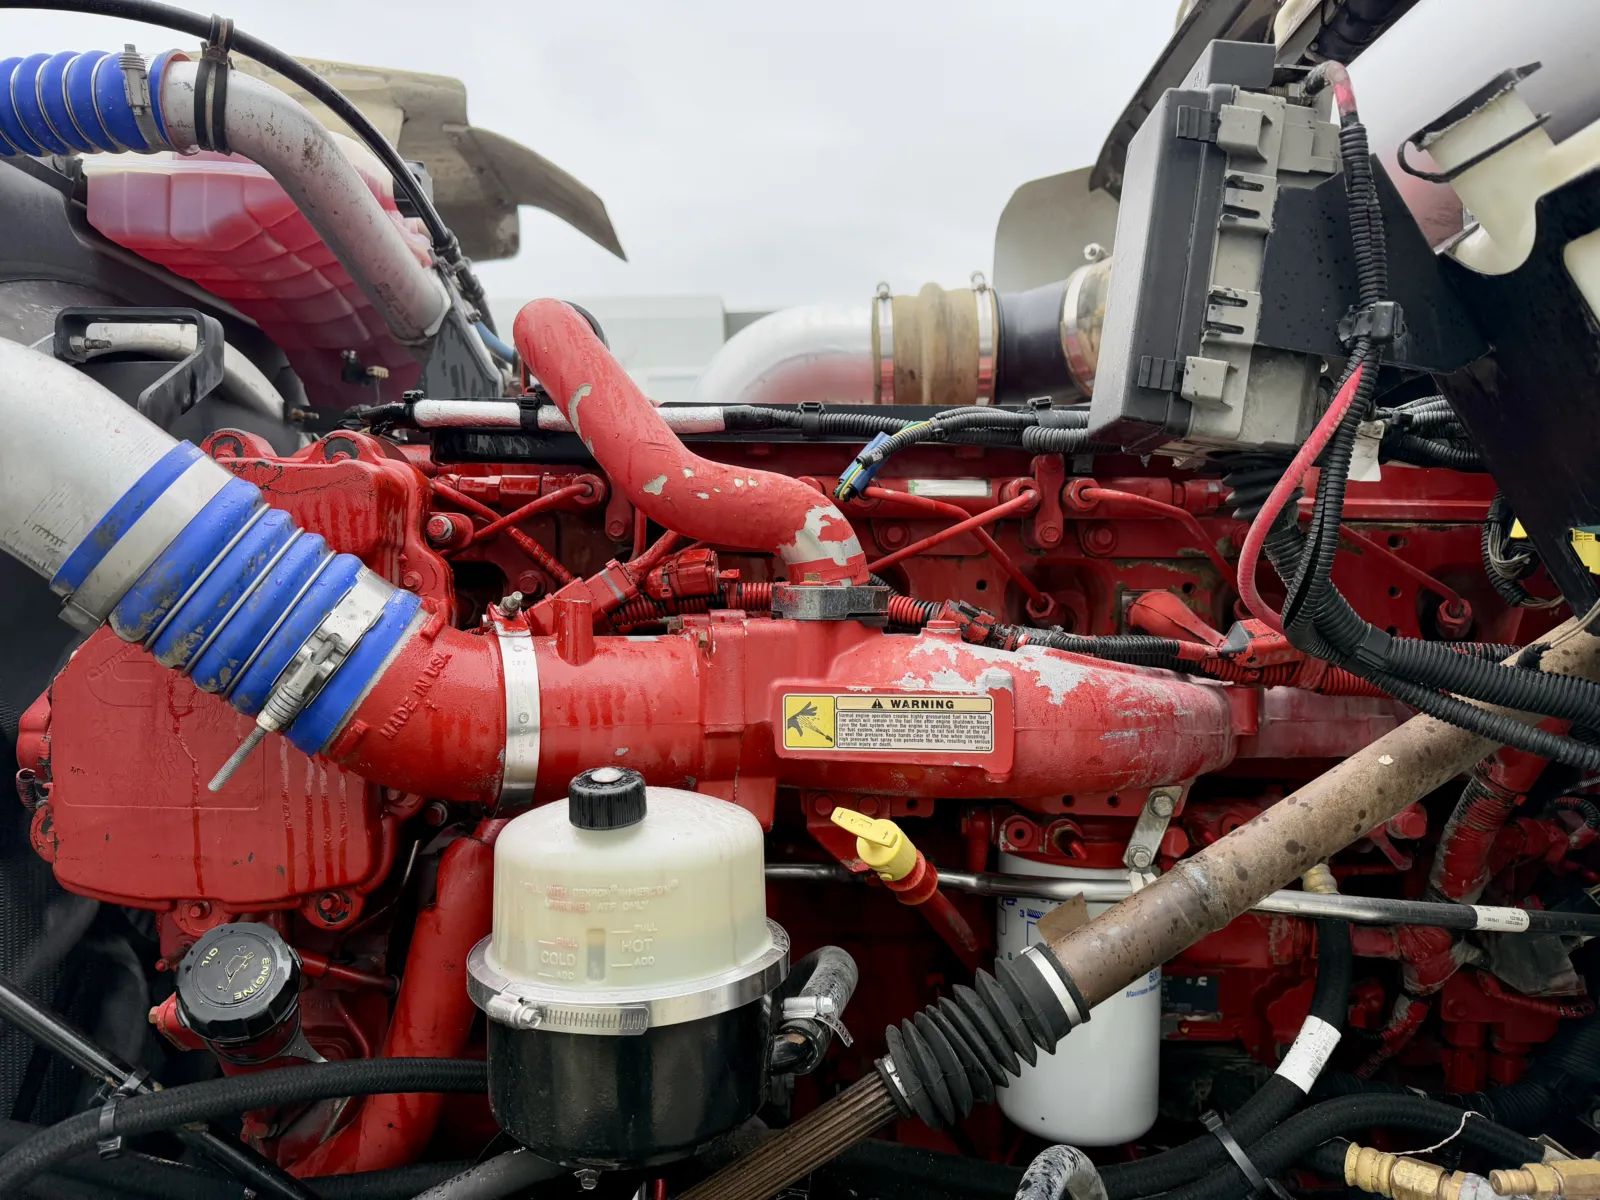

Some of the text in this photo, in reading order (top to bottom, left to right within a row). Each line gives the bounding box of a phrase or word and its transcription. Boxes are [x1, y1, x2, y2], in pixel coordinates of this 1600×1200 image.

[379, 653, 453, 741] MADE IN USA
[890, 700, 954, 710] WARNING
[597, 901, 617, 912] ATF
[621, 899, 650, 911] ONLY
[1020, 909, 1025, 918] 3
[634, 922, 658, 932] FULL
[556, 936, 578, 948] FULL
[621, 937, 653, 953] HOT
[200, 947, 219, 967] OIL
[541, 950, 576, 967] COLD
[634, 955, 655, 966] ADD
[233, 956, 272, 1001] ENGINE
[556, 970, 575, 980] ADD
